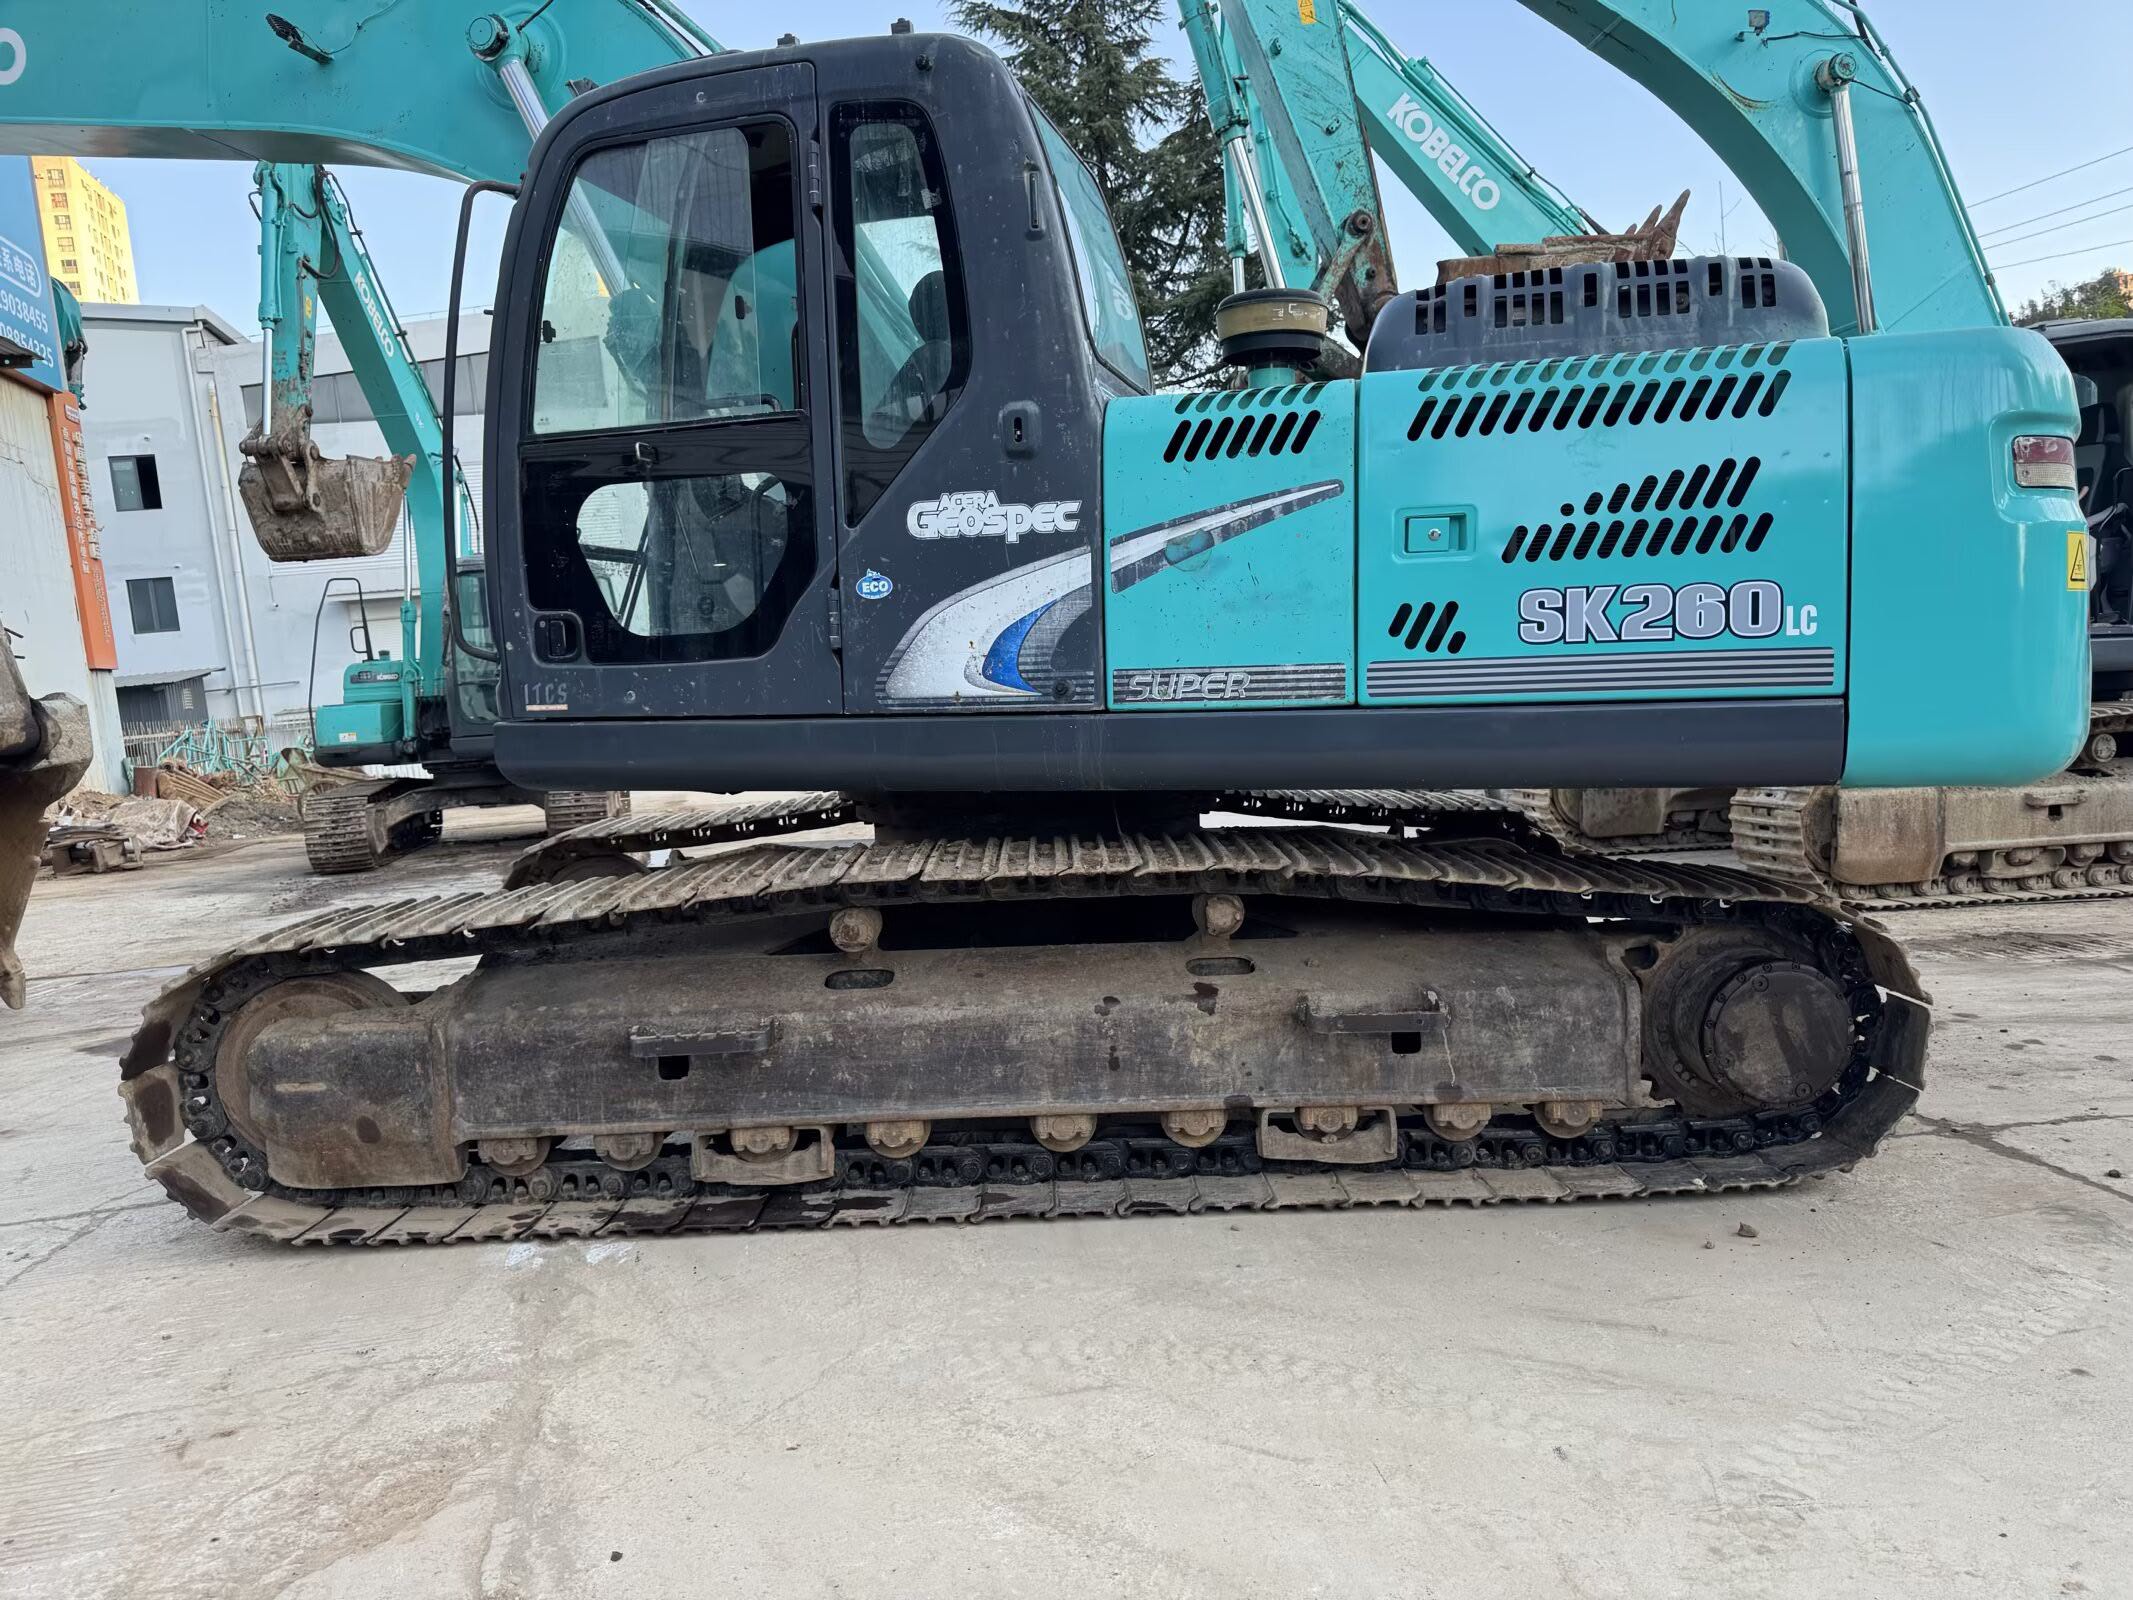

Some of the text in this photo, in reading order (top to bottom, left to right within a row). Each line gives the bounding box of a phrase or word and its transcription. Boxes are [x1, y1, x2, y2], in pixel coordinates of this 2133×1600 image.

[1386, 92, 1501, 211] KOBELCO
[0, 246, 37, 289] 系电话
[0, 289, 49, 335] 9038455
[353, 270, 394, 358] KOBELCO
[938, 490, 1000, 511] ACERA
[861, 580, 889, 593] ECO
[1126, 671, 1251, 701] SUPER
